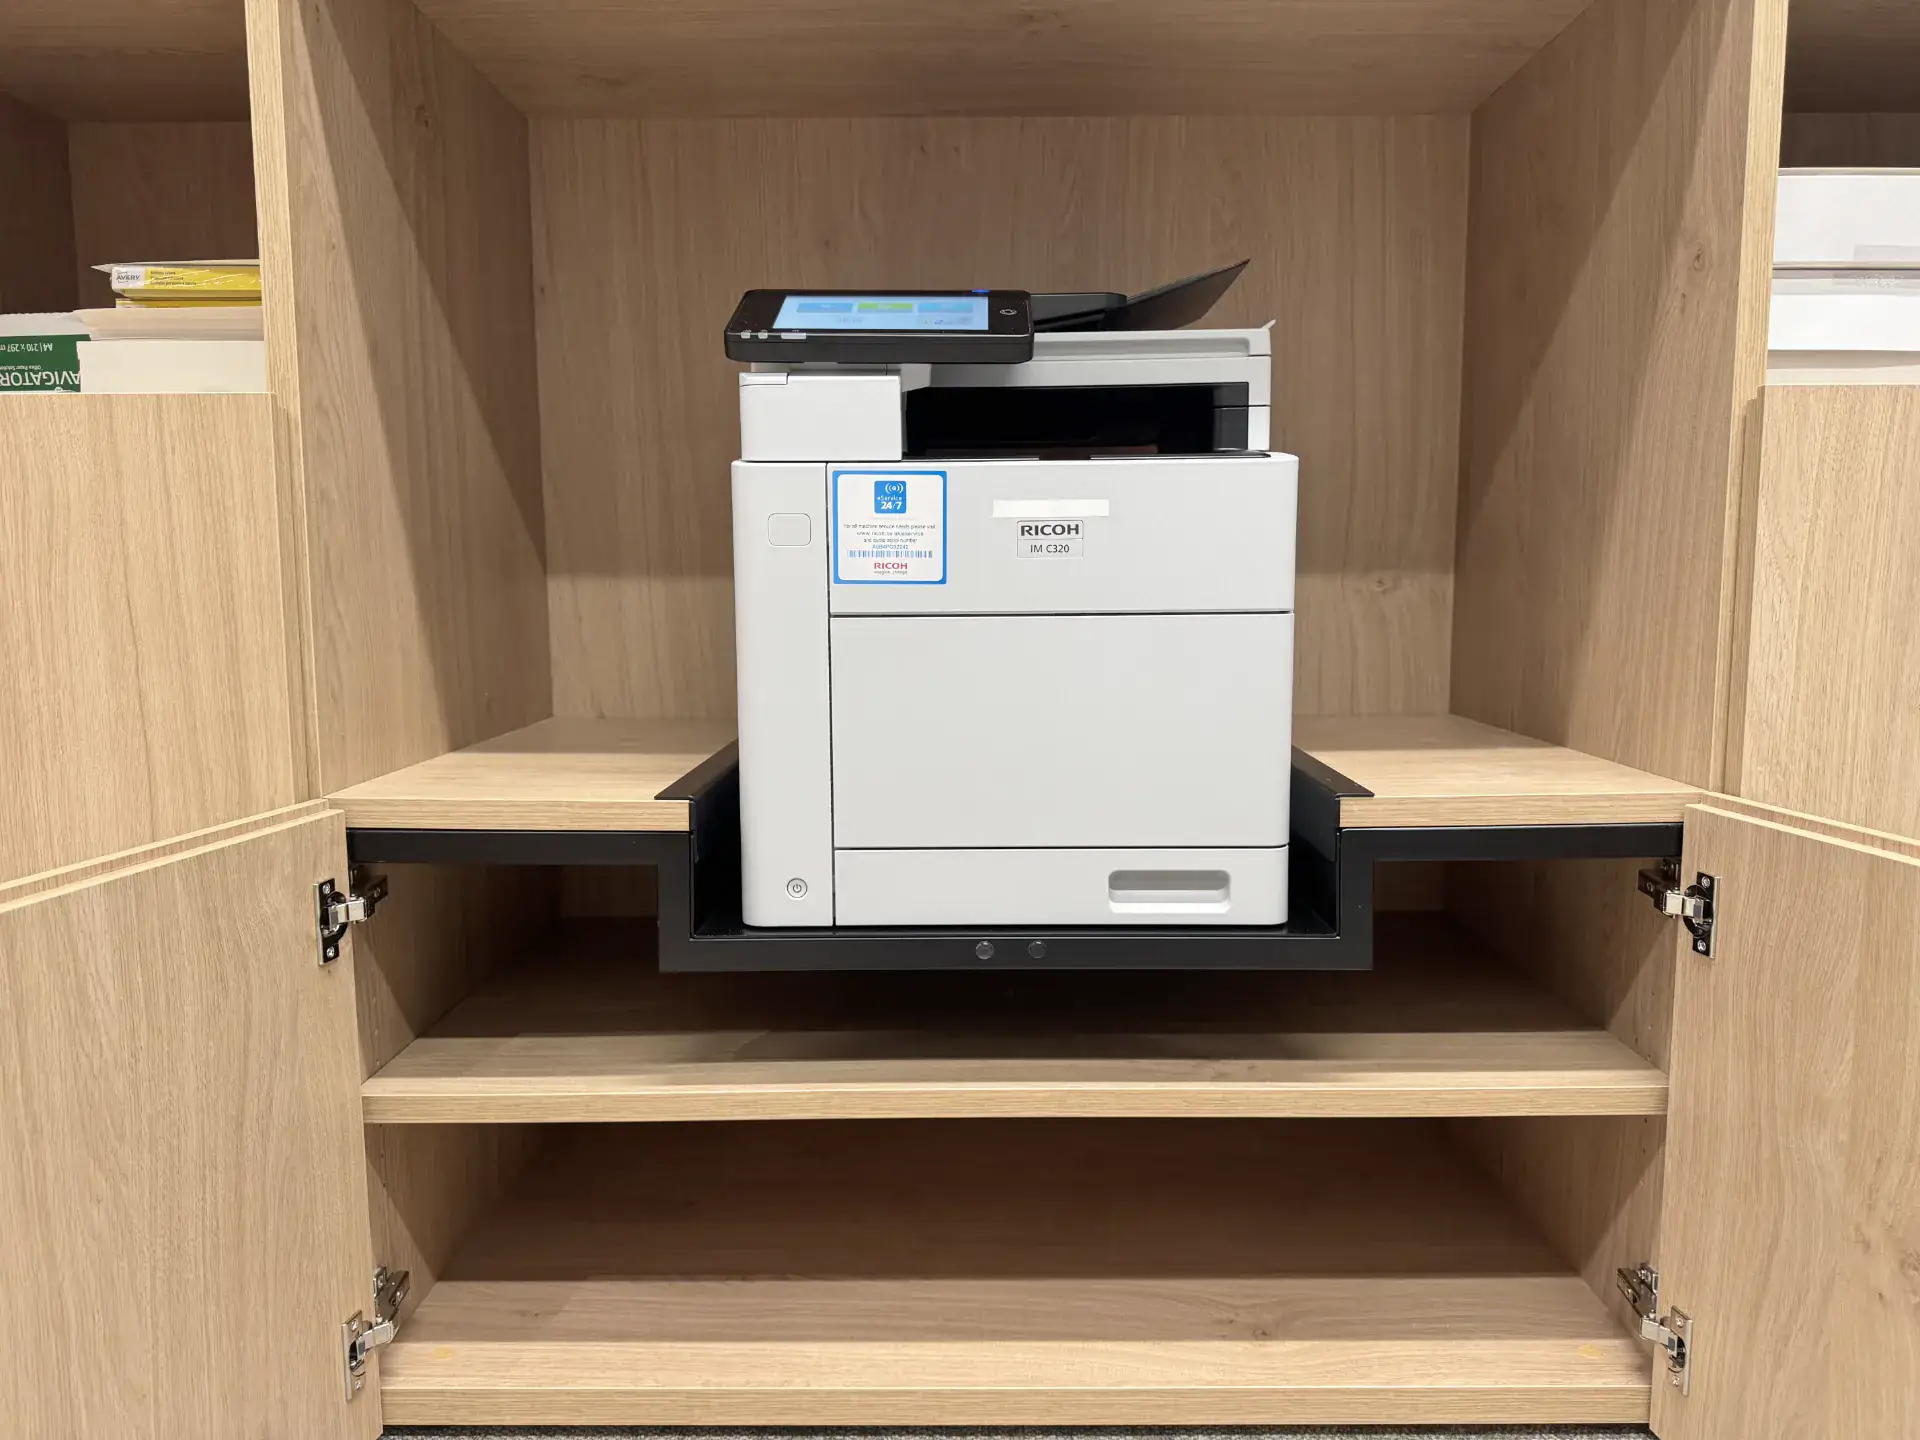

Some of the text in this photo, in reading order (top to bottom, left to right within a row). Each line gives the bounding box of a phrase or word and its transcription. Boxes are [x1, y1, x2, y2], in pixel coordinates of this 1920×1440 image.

[7, 343, 19, 351] 297
[27, 343, 38, 351] 210
[43, 343, 53, 351] A4
[881, 501, 902, 510] 24/7
[1021, 524, 1079, 536] RICOH
[1030, 544, 1070, 553] IM C320
[874, 562, 908, 570] RICOH
